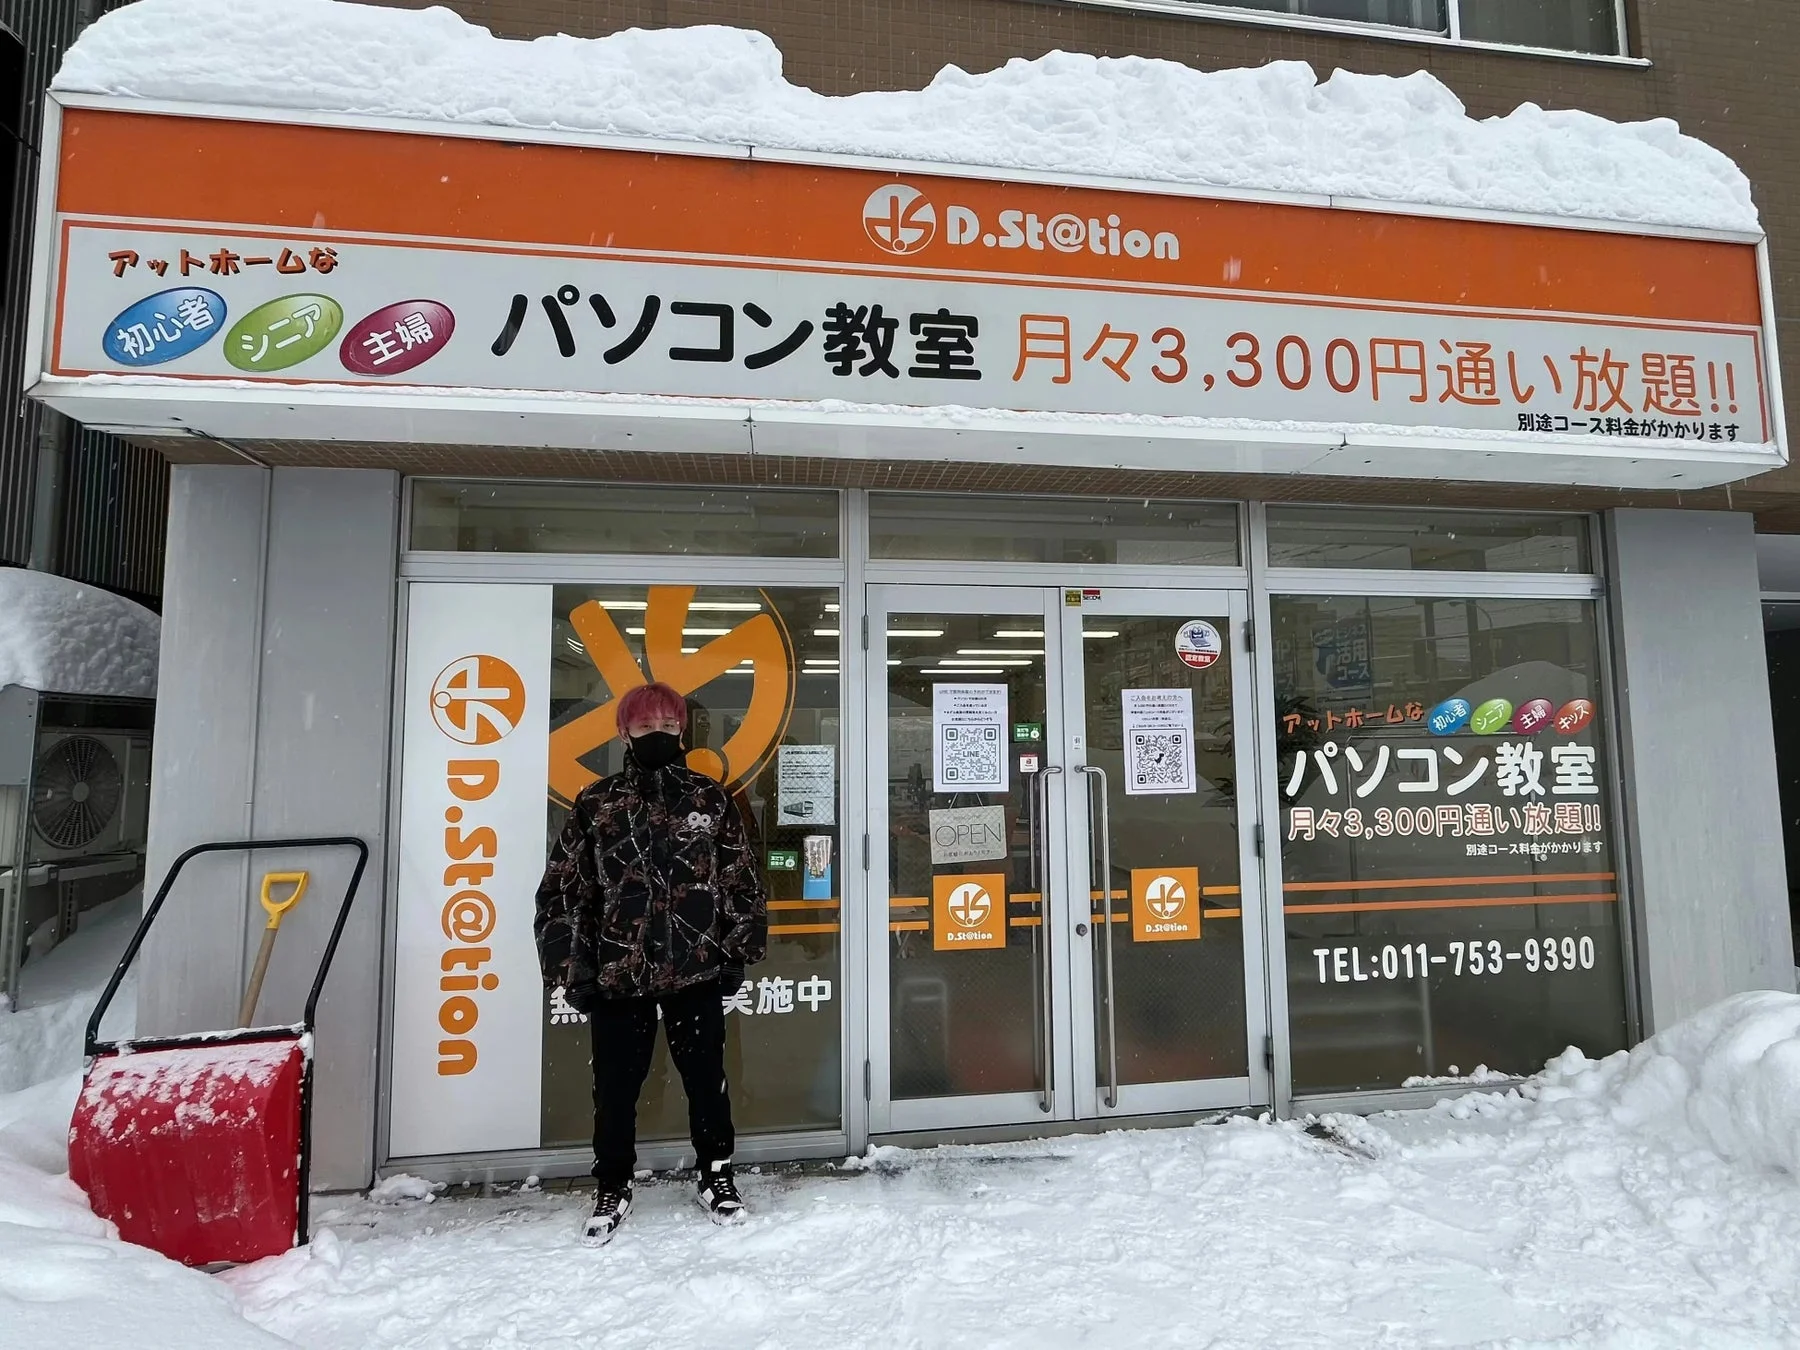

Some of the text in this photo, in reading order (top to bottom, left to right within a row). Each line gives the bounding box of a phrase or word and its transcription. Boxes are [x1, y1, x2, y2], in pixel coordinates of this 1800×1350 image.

[946, 204, 1181, 261] D.St@tion
[107, 245, 340, 279] アットホームな
[116, 294, 435, 367] 初心者 シニア 主婦
[490, 283, 1740, 418] パソコン教室 月々3,300円通い放題!!
[1516, 412, 1741, 442] 別途コース料金がかかります
[1335, 639, 1369, 664] 活用
[1336, 662, 1371, 681] コース
[1282, 702, 1425, 735] アットホームな
[1432, 702, 1468, 732] 初心者
[1475, 702, 1507, 730] シニア
[1518, 704, 1547, 730] 主婦
[962, 750, 980, 758] LINE
[1285, 740, 1600, 798] パソコン教室
[935, 823, 1002, 847] OPEN
[1288, 801, 1602, 842] 月々3,300円通い放題!!
[1465, 840, 1603, 857] 別途コース料金がかかります
[437, 759, 501, 1077] D.St@tion
[1145, 922, 1188, 933] D.St@tion
[947, 930, 993, 941] D.St@tion
[1312, 935, 1596, 984] TEL:011-753-9390
